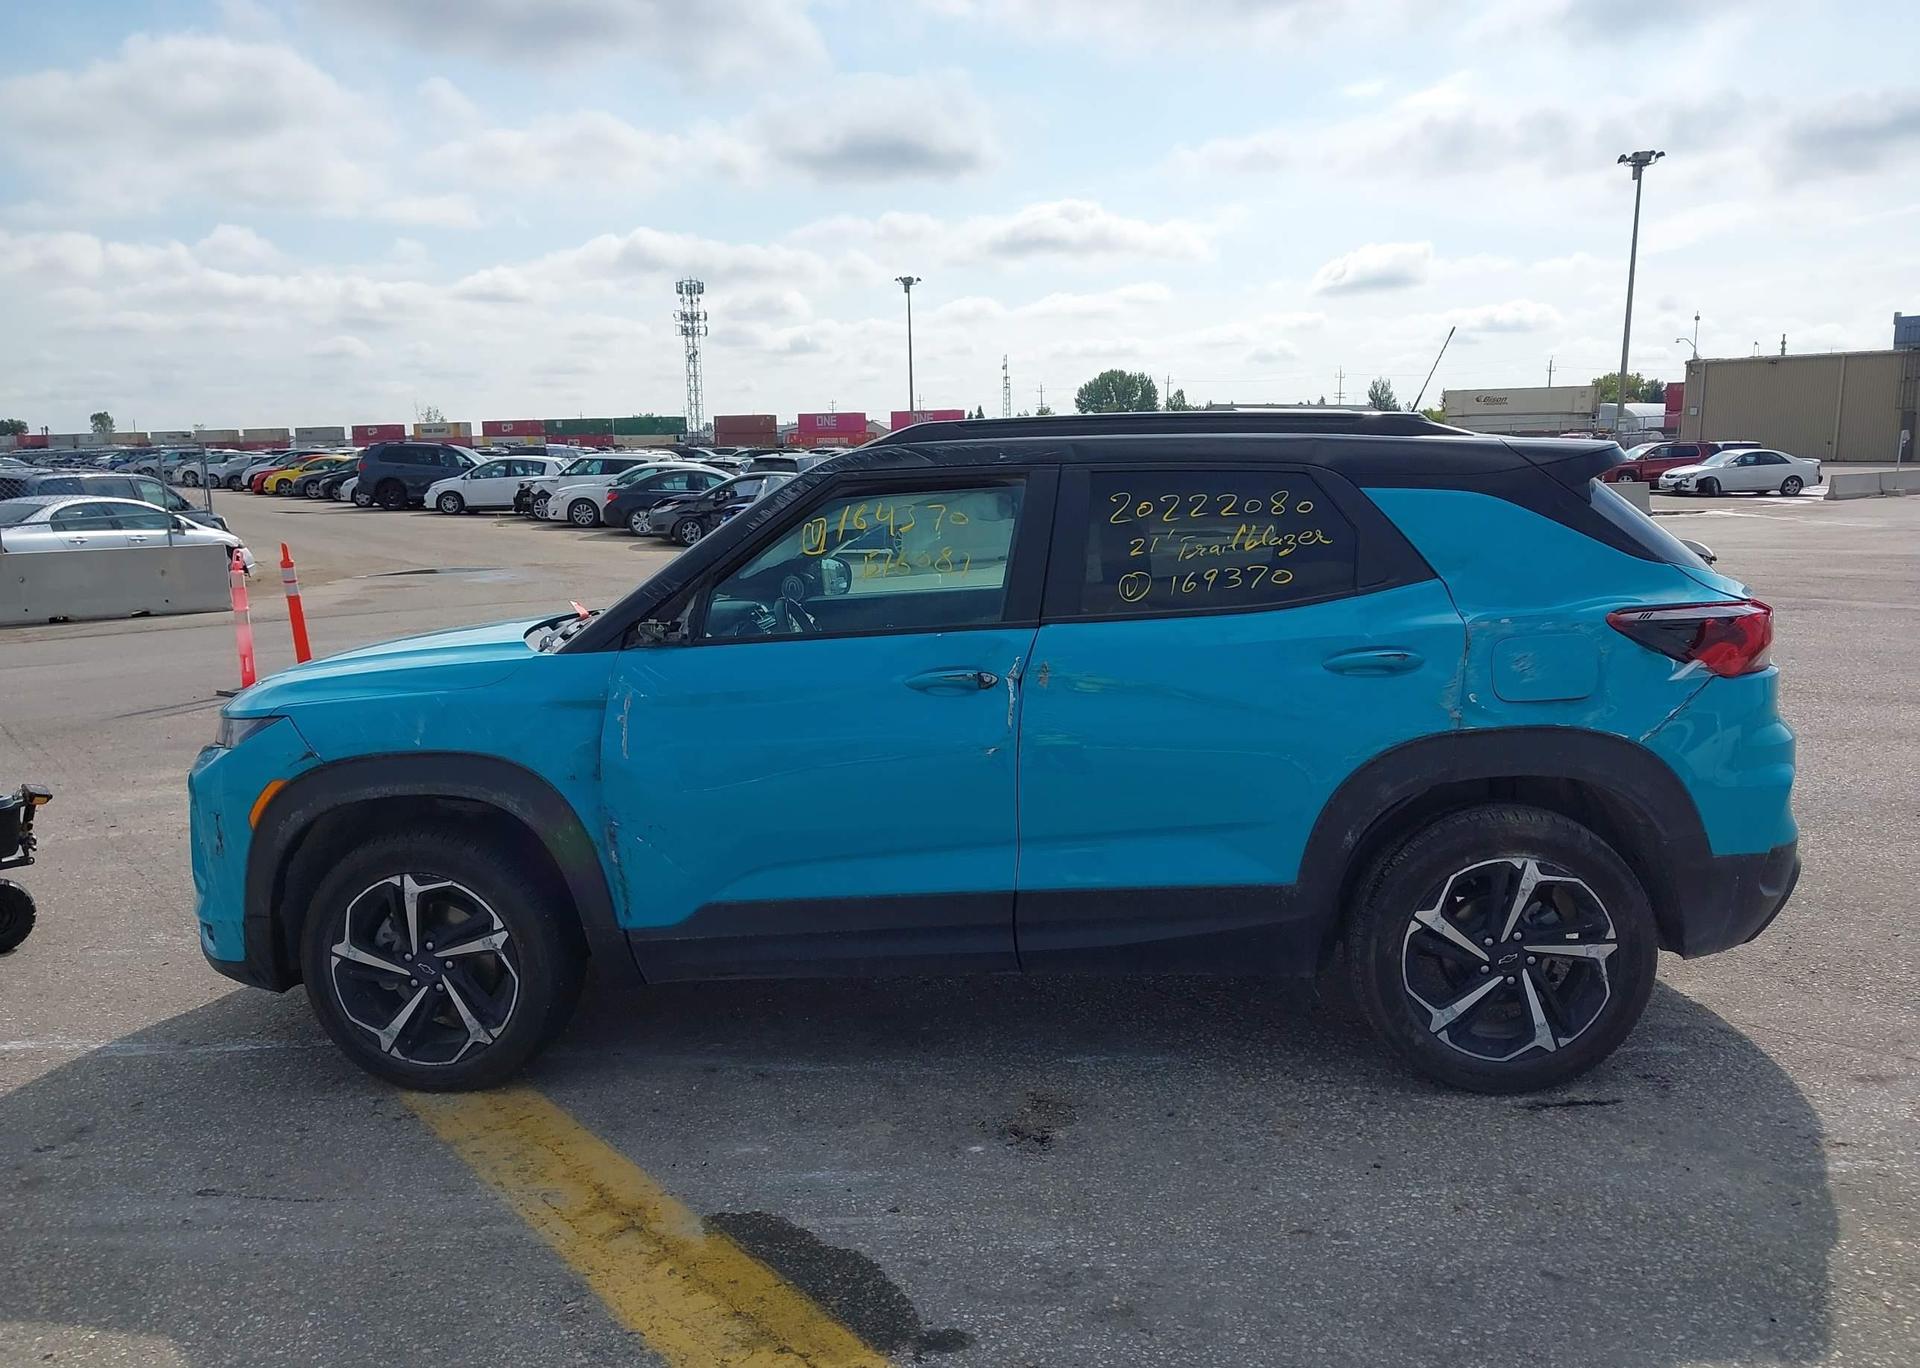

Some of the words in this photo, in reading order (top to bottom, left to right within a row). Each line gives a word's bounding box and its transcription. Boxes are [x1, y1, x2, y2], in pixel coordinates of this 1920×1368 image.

[501, 424, 514, 433] CP
[816, 415, 837, 426] ONE
[912, 412, 934, 424] ONE
[1109, 490, 1314, 524] 20222080
[1176, 523, 1334, 562] Trailblazer
[1170, 565, 1294, 597] 169370
